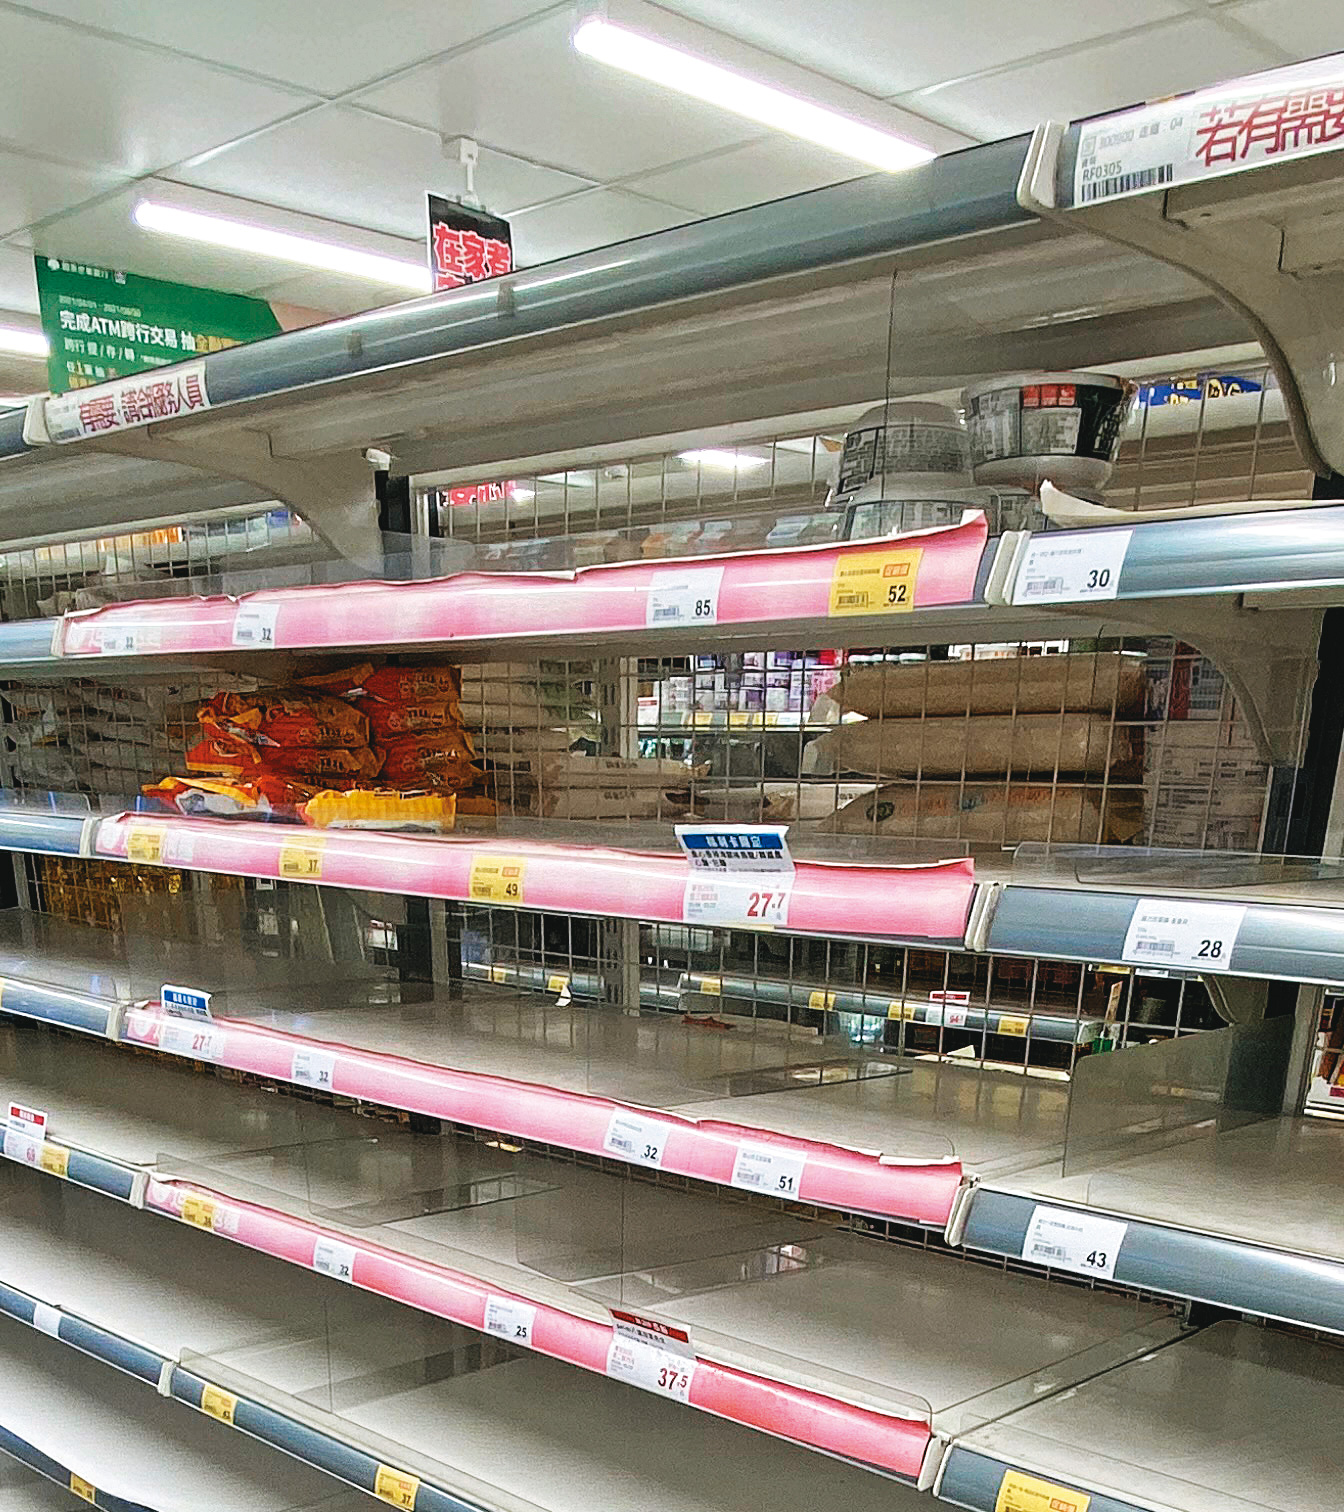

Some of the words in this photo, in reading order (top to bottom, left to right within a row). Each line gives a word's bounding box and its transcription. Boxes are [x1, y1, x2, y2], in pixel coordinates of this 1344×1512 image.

[1082, 162, 1122, 182] RF0305
[1086, 568, 1111, 588] 30
[888, 584, 906, 603] 52
[695, 600, 711, 616] 85
[309, 859, 318, 873] 37
[506, 882, 519, 898] 49
[1199, 940, 1223, 959] 28
[319, 1069, 329, 1084] 32
[644, 1144, 658, 1160] 32
[778, 1175, 794, 1191] 51
[1086, 1250, 1107, 1269] 43
[516, 1325, 528, 1339] 25
[658, 1367, 688, 1390] 37.5
